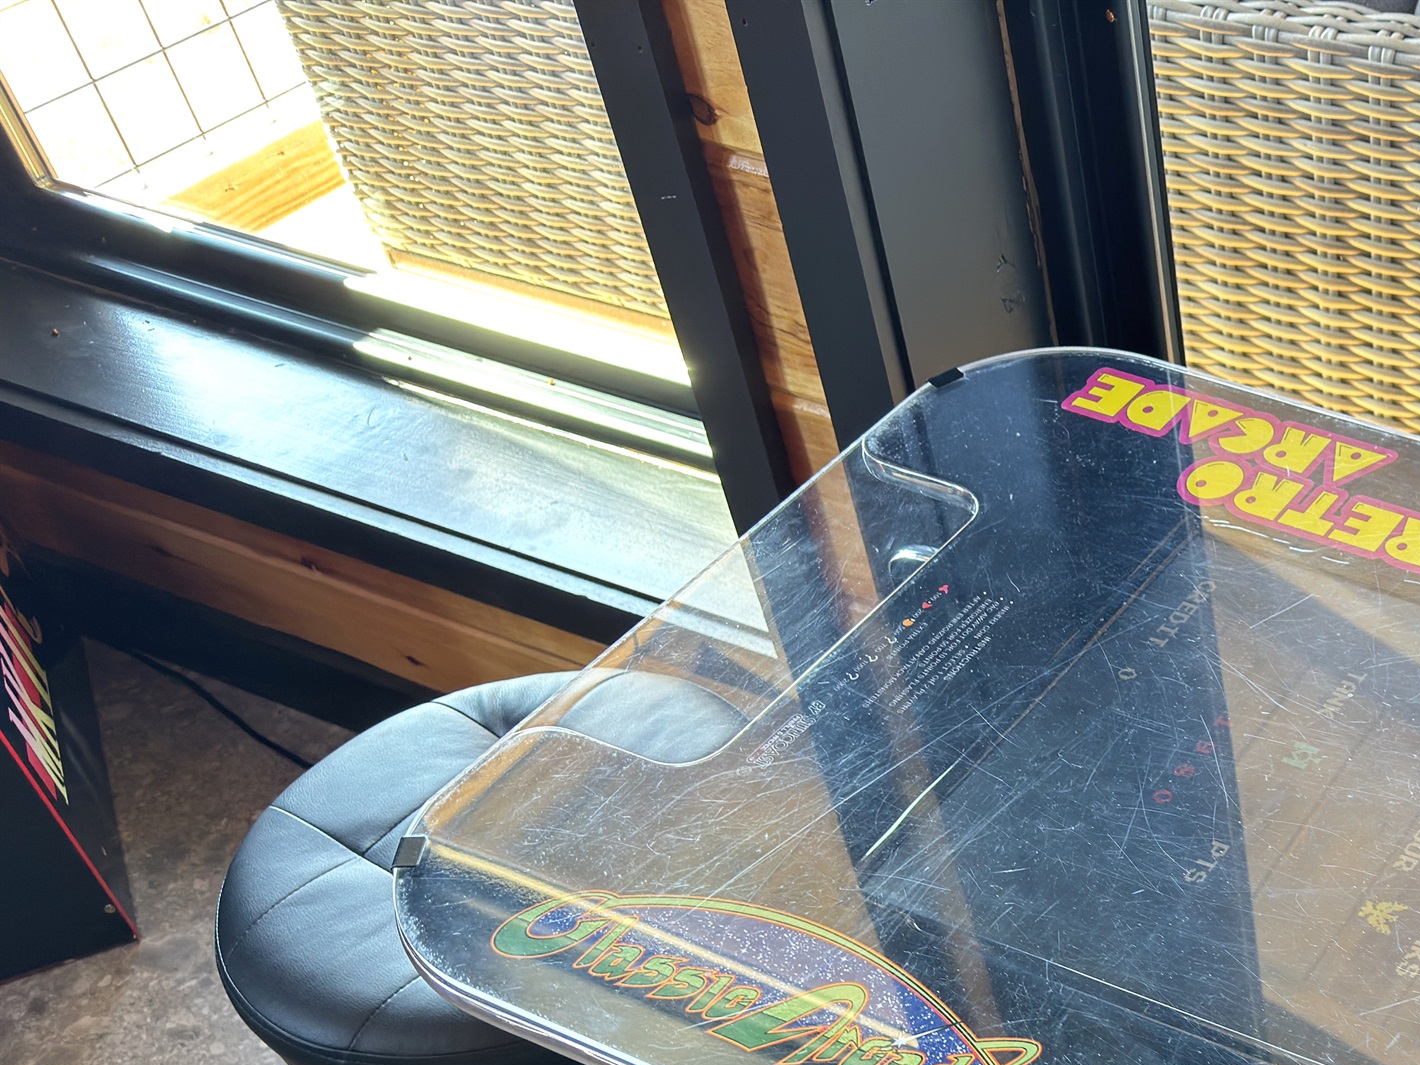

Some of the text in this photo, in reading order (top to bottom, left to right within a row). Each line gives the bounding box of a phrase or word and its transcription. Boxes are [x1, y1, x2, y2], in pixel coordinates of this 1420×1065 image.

[1072, 374, 1387, 481] ARCADE
[1148, 580, 1217, 649] CREDIT
[941, 636, 992, 680] INSTRUCTIONS
[1316, 672, 1369, 720] TANK
[1183, 840, 1231, 883] PTS
[490, 890, 763, 1019] Classic
